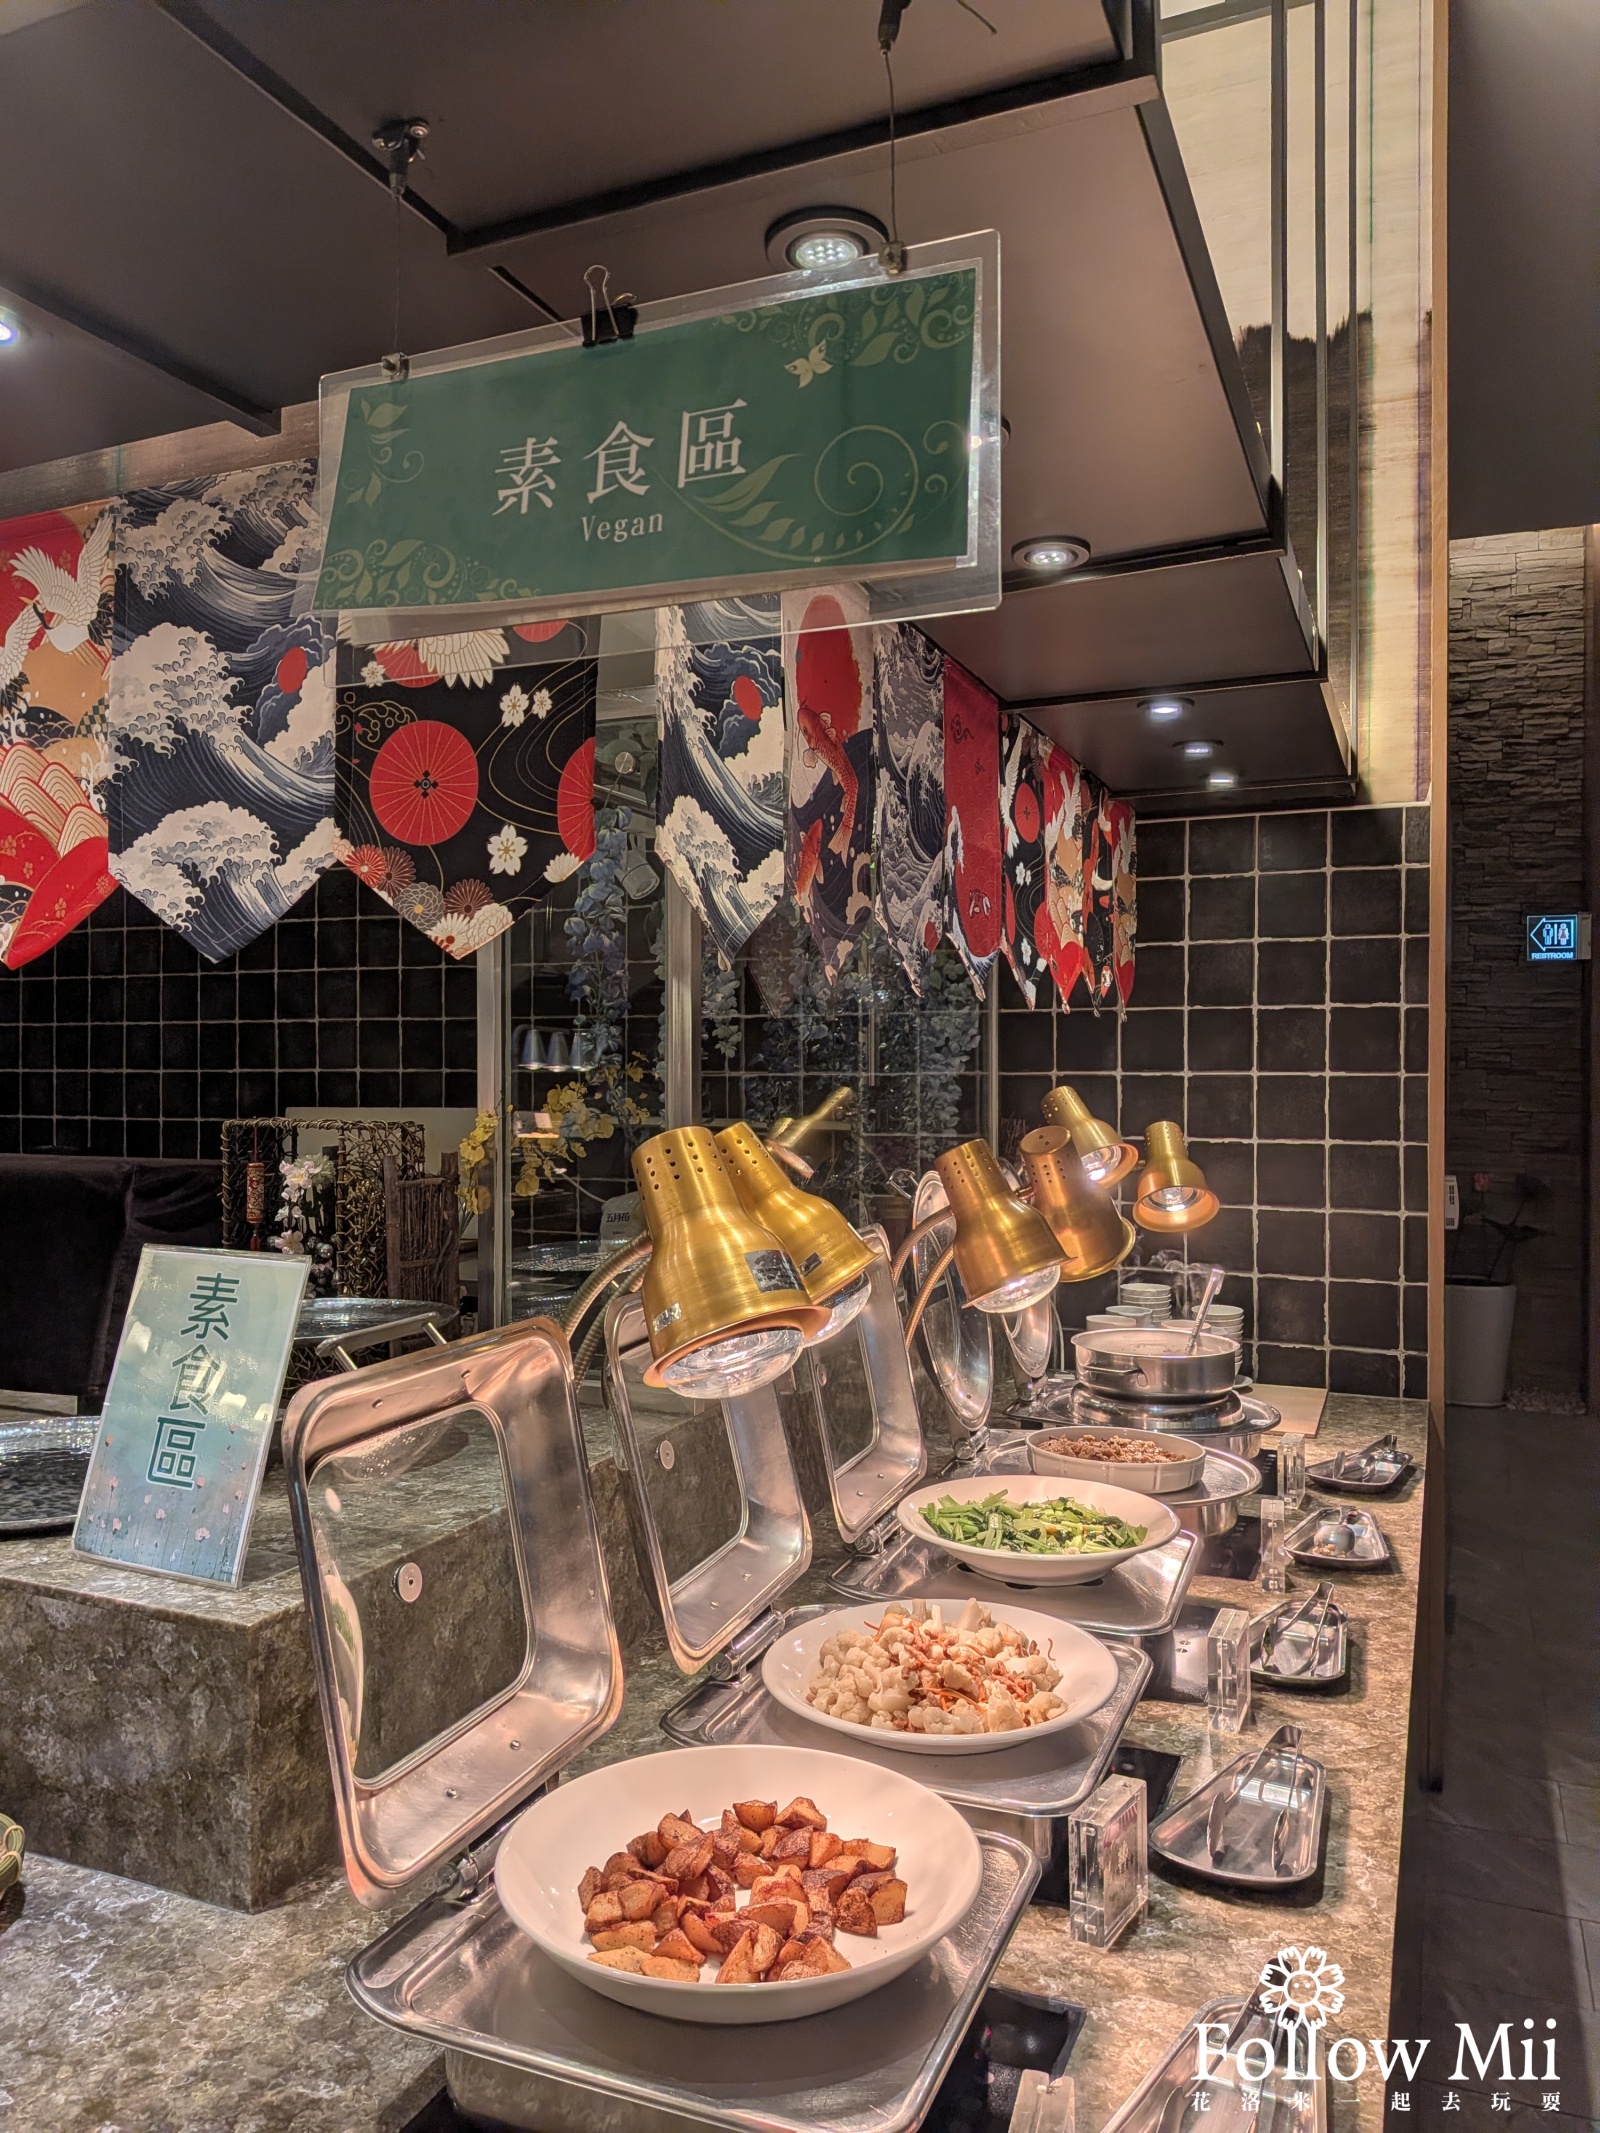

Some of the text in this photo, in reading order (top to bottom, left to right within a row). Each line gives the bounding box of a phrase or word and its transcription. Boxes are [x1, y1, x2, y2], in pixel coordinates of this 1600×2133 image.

[492, 398, 748, 517] 素食區
[580, 510, 664, 544] Vegan
[1531, 952, 1574, 960] RESTROOM
[606, 1212, 631, 1223] 五月花
[146, 1272, 240, 1490] 素食區
